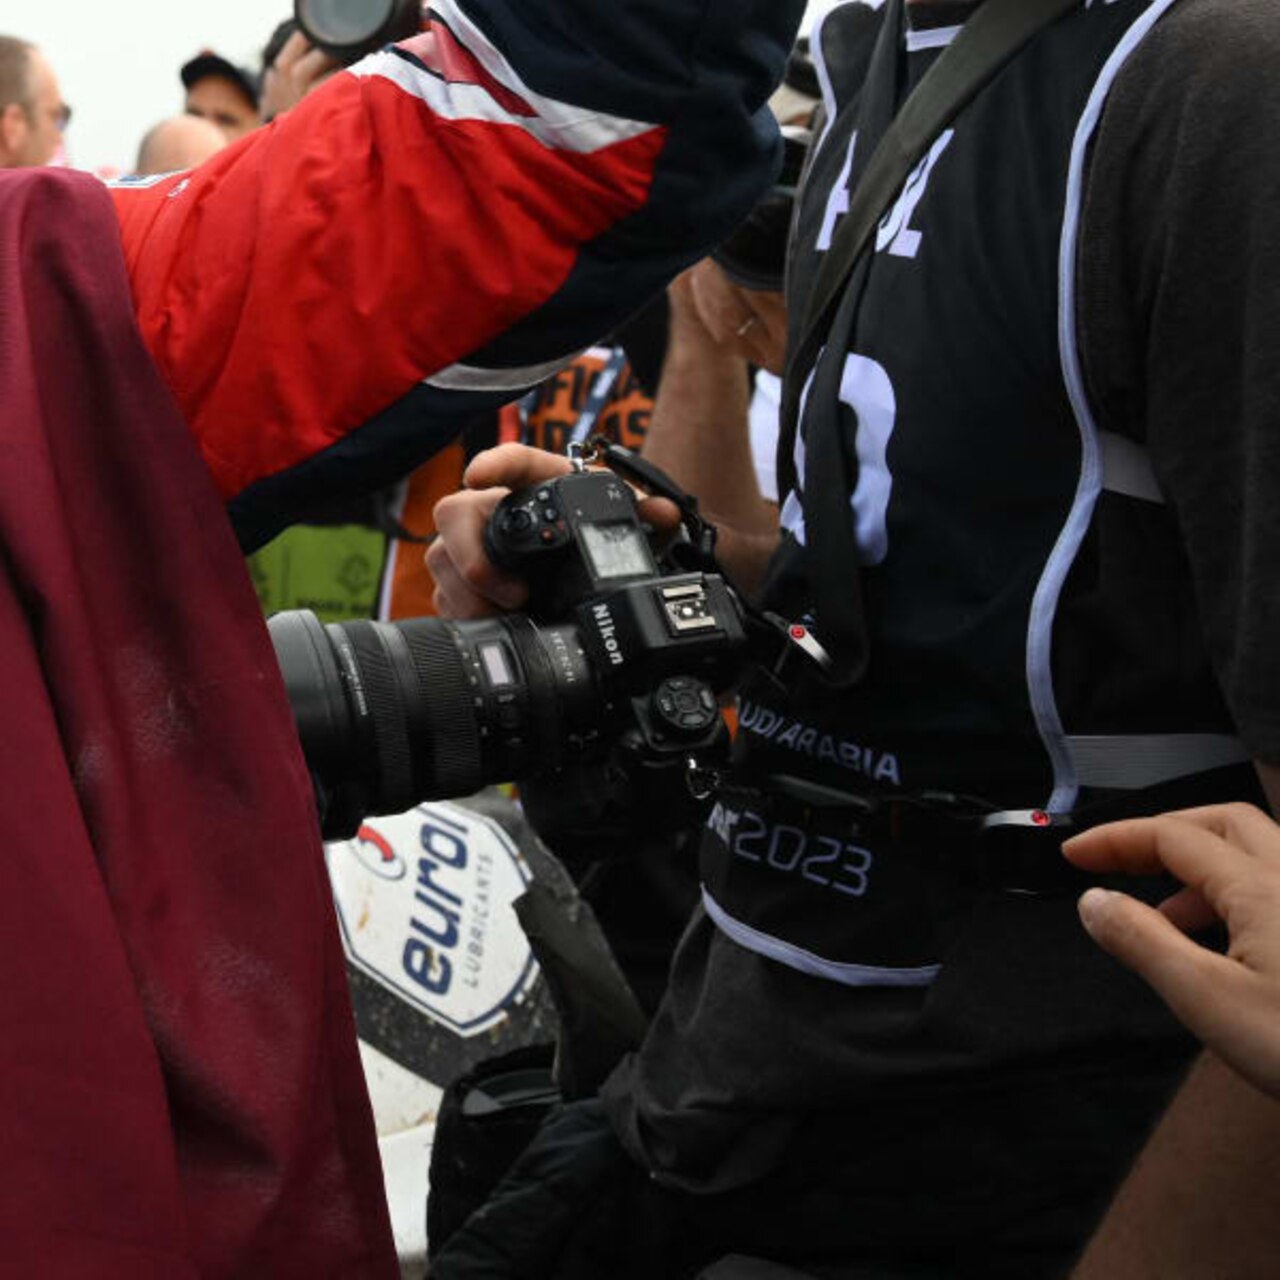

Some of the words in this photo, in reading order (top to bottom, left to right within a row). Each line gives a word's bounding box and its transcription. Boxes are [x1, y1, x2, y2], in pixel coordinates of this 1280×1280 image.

[592, 602, 624, 665] Nikon
[739, 701, 783, 737] UDI
[776, 723, 901, 786] ARABIA
[734, 808, 873, 897] 2023
[464, 852, 494, 989] LUBRICANTS
